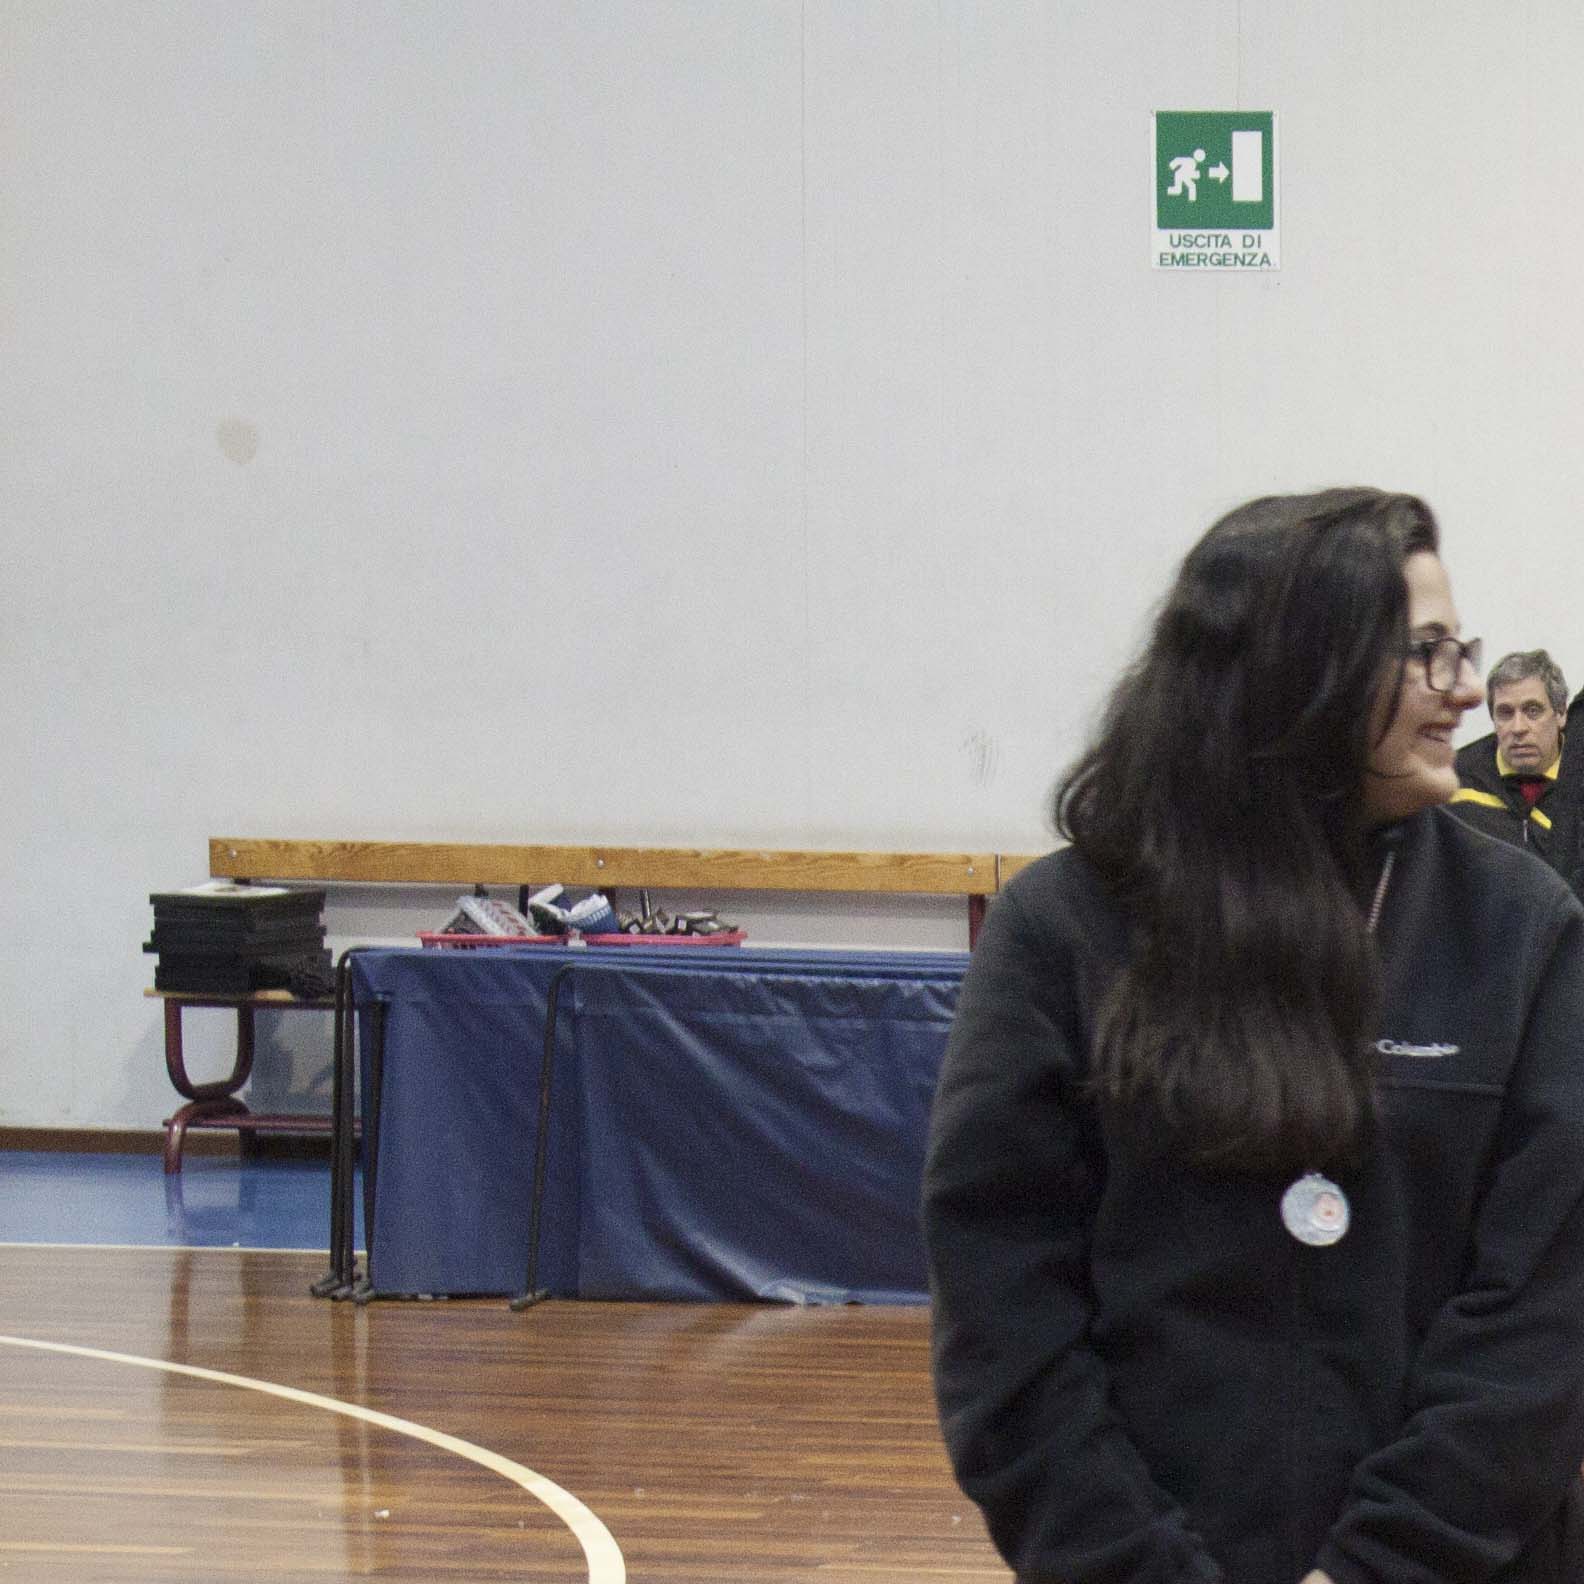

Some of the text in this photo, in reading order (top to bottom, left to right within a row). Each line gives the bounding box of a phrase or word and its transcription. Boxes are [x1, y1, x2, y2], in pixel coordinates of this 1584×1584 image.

[1169, 233, 1261, 249] USCITA DI
[1159, 252, 1272, 267] EMERGENZA
